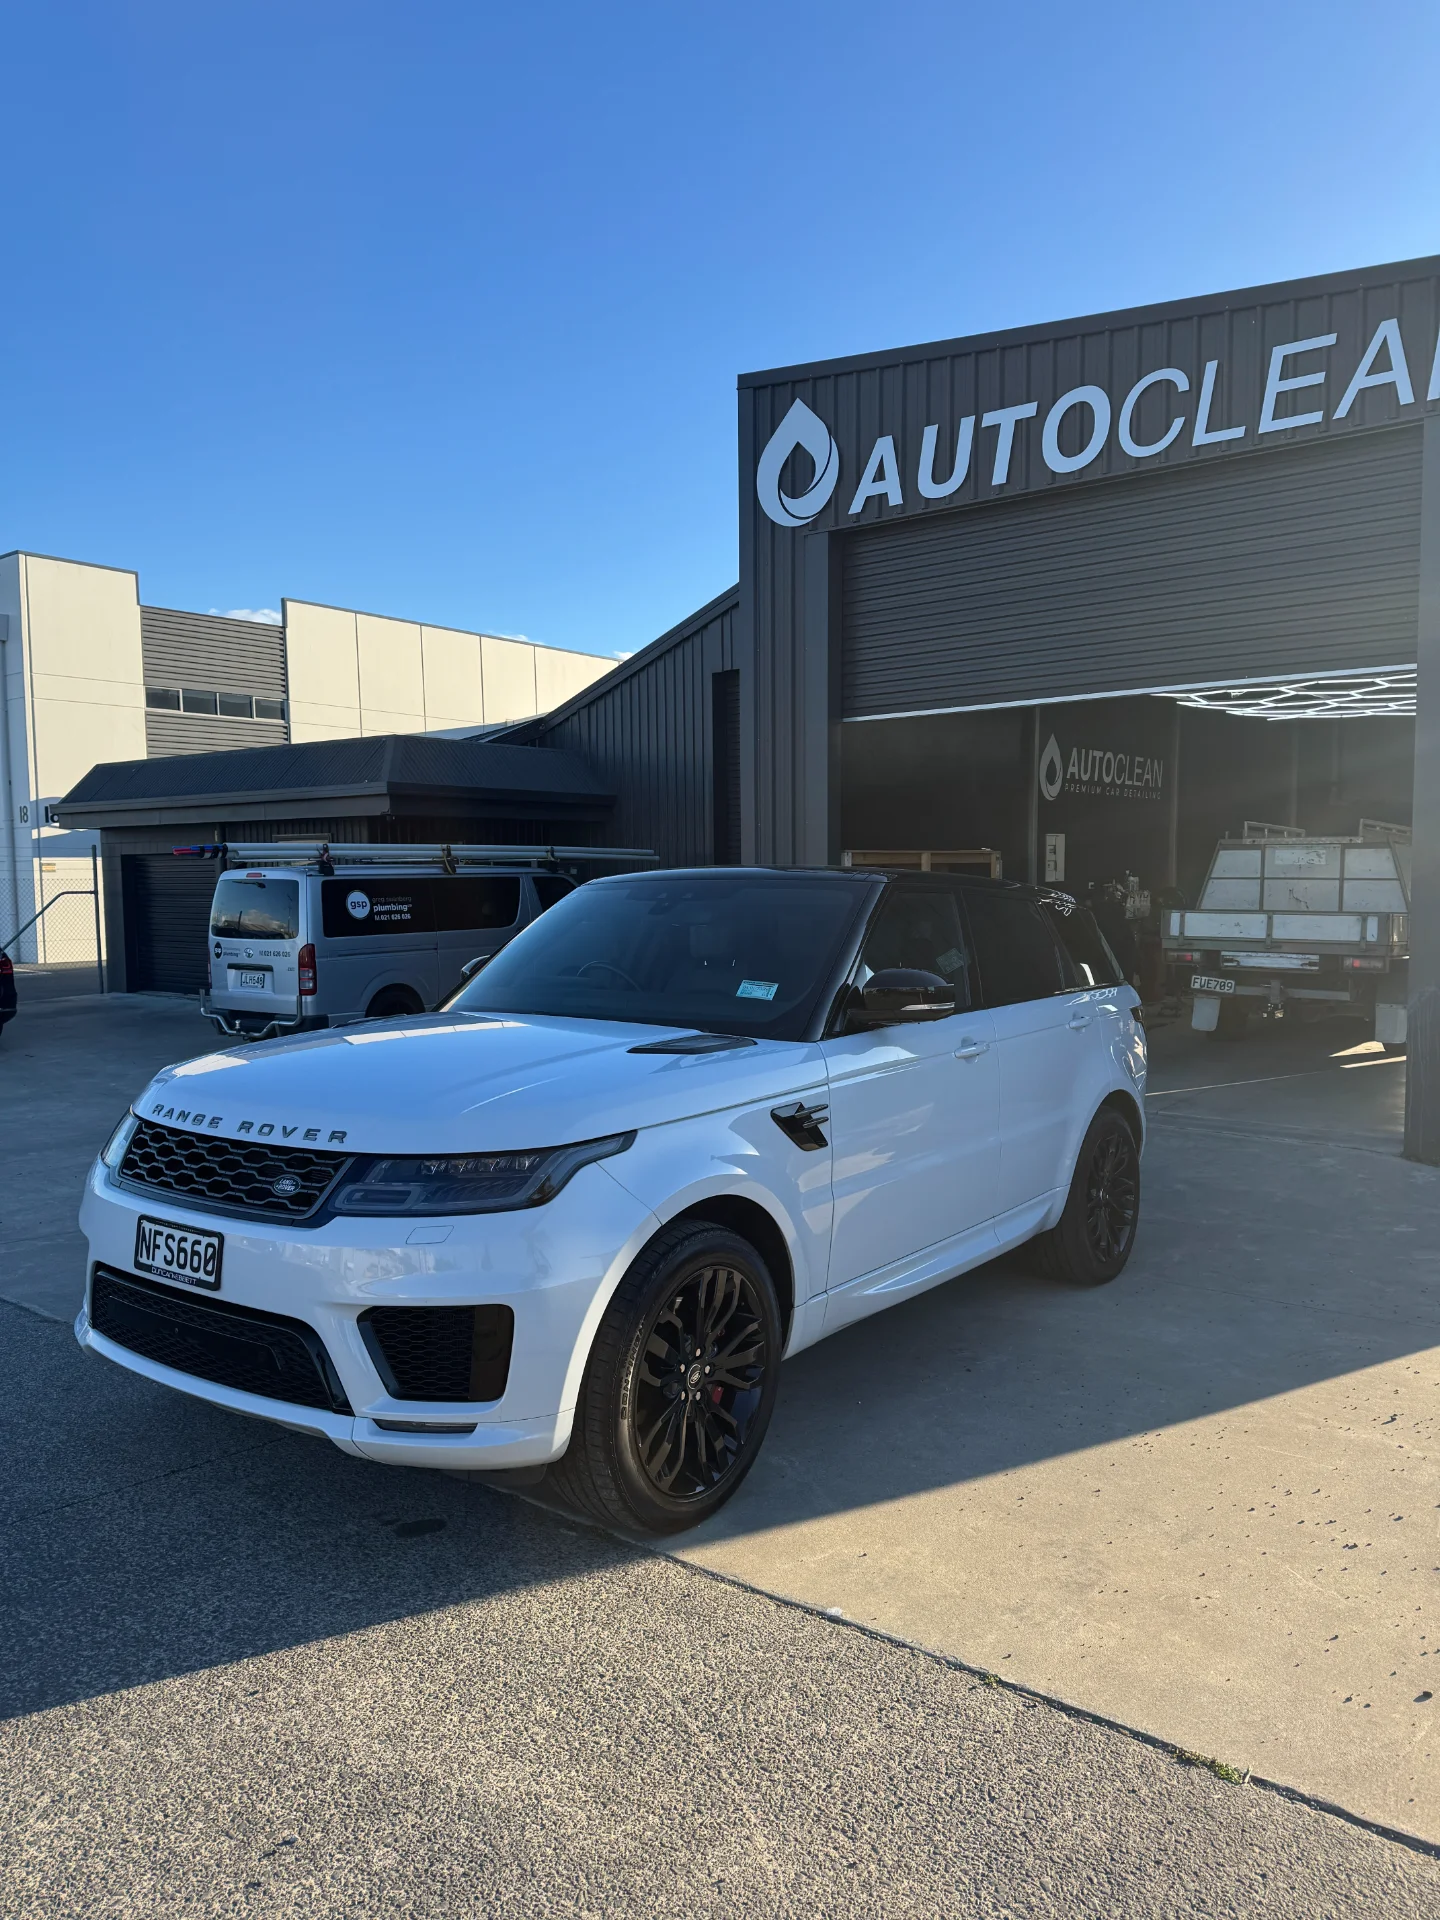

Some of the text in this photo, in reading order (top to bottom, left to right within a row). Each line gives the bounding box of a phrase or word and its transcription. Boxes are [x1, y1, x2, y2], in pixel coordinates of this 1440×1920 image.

[848, 317, 1440, 515] AUTOCLEA
[1066, 747, 1163, 788] AUTOCLEAN
[1064, 783, 1161, 800] PREMIUM CAR DETAILING
[19, 805, 29, 824] 18
[350, 901, 368, 910] gsp
[373, 903, 408, 912] plumbing
[1192, 976, 1233, 991] FUE709
[152, 1103, 348, 1144] RANGE ROVER
[140, 1226, 217, 1277] NFS660
